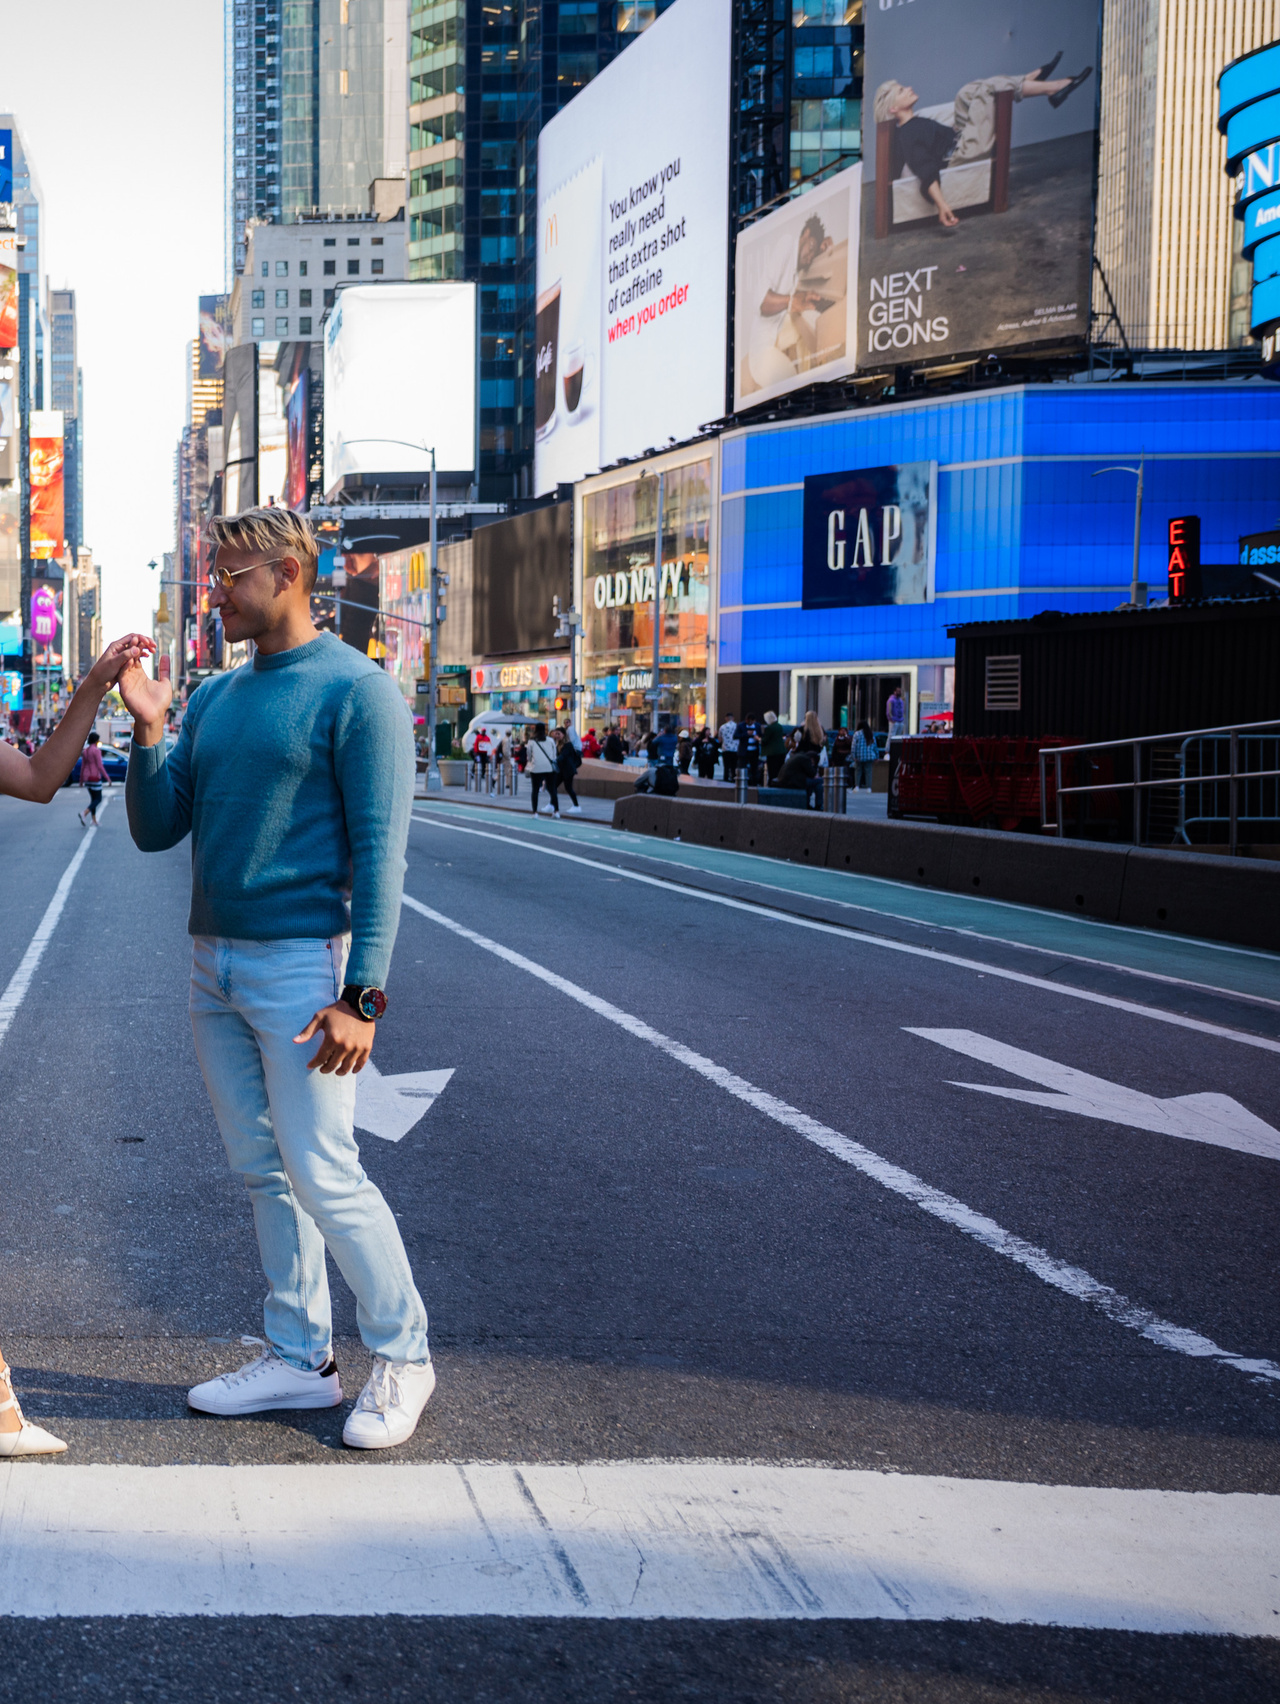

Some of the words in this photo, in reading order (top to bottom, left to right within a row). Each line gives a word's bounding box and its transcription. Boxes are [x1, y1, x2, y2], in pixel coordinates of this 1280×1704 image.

[609, 199, 627, 223] You
[630, 175, 658, 205] know
[660, 157, 681, 194] you
[609, 217, 637, 254] really
[639, 196, 665, 235] need
[609, 256, 630, 285] that
[631, 239, 658, 273] extra
[661, 216, 686, 251] shot
[608, 292, 619, 315] of
[620, 266, 663, 309] caffeine
[870, 265, 938, 301] NEXT
[608, 312, 635, 343] when
[637, 301, 657, 335] you
[658, 283, 689, 316] order
[868, 316, 950, 353] ICONS
[869, 295, 923, 327] GEN
[827, 505, 901, 571] GAP
[1168, 520, 1185, 597] EAT
[594, 571, 628, 609] OLD
[630, 561, 684, 604] NAVY
[500, 666, 533, 688] GIFTS
[622, 675, 636, 690] OLD
[637, 674, 653, 689] NAV
